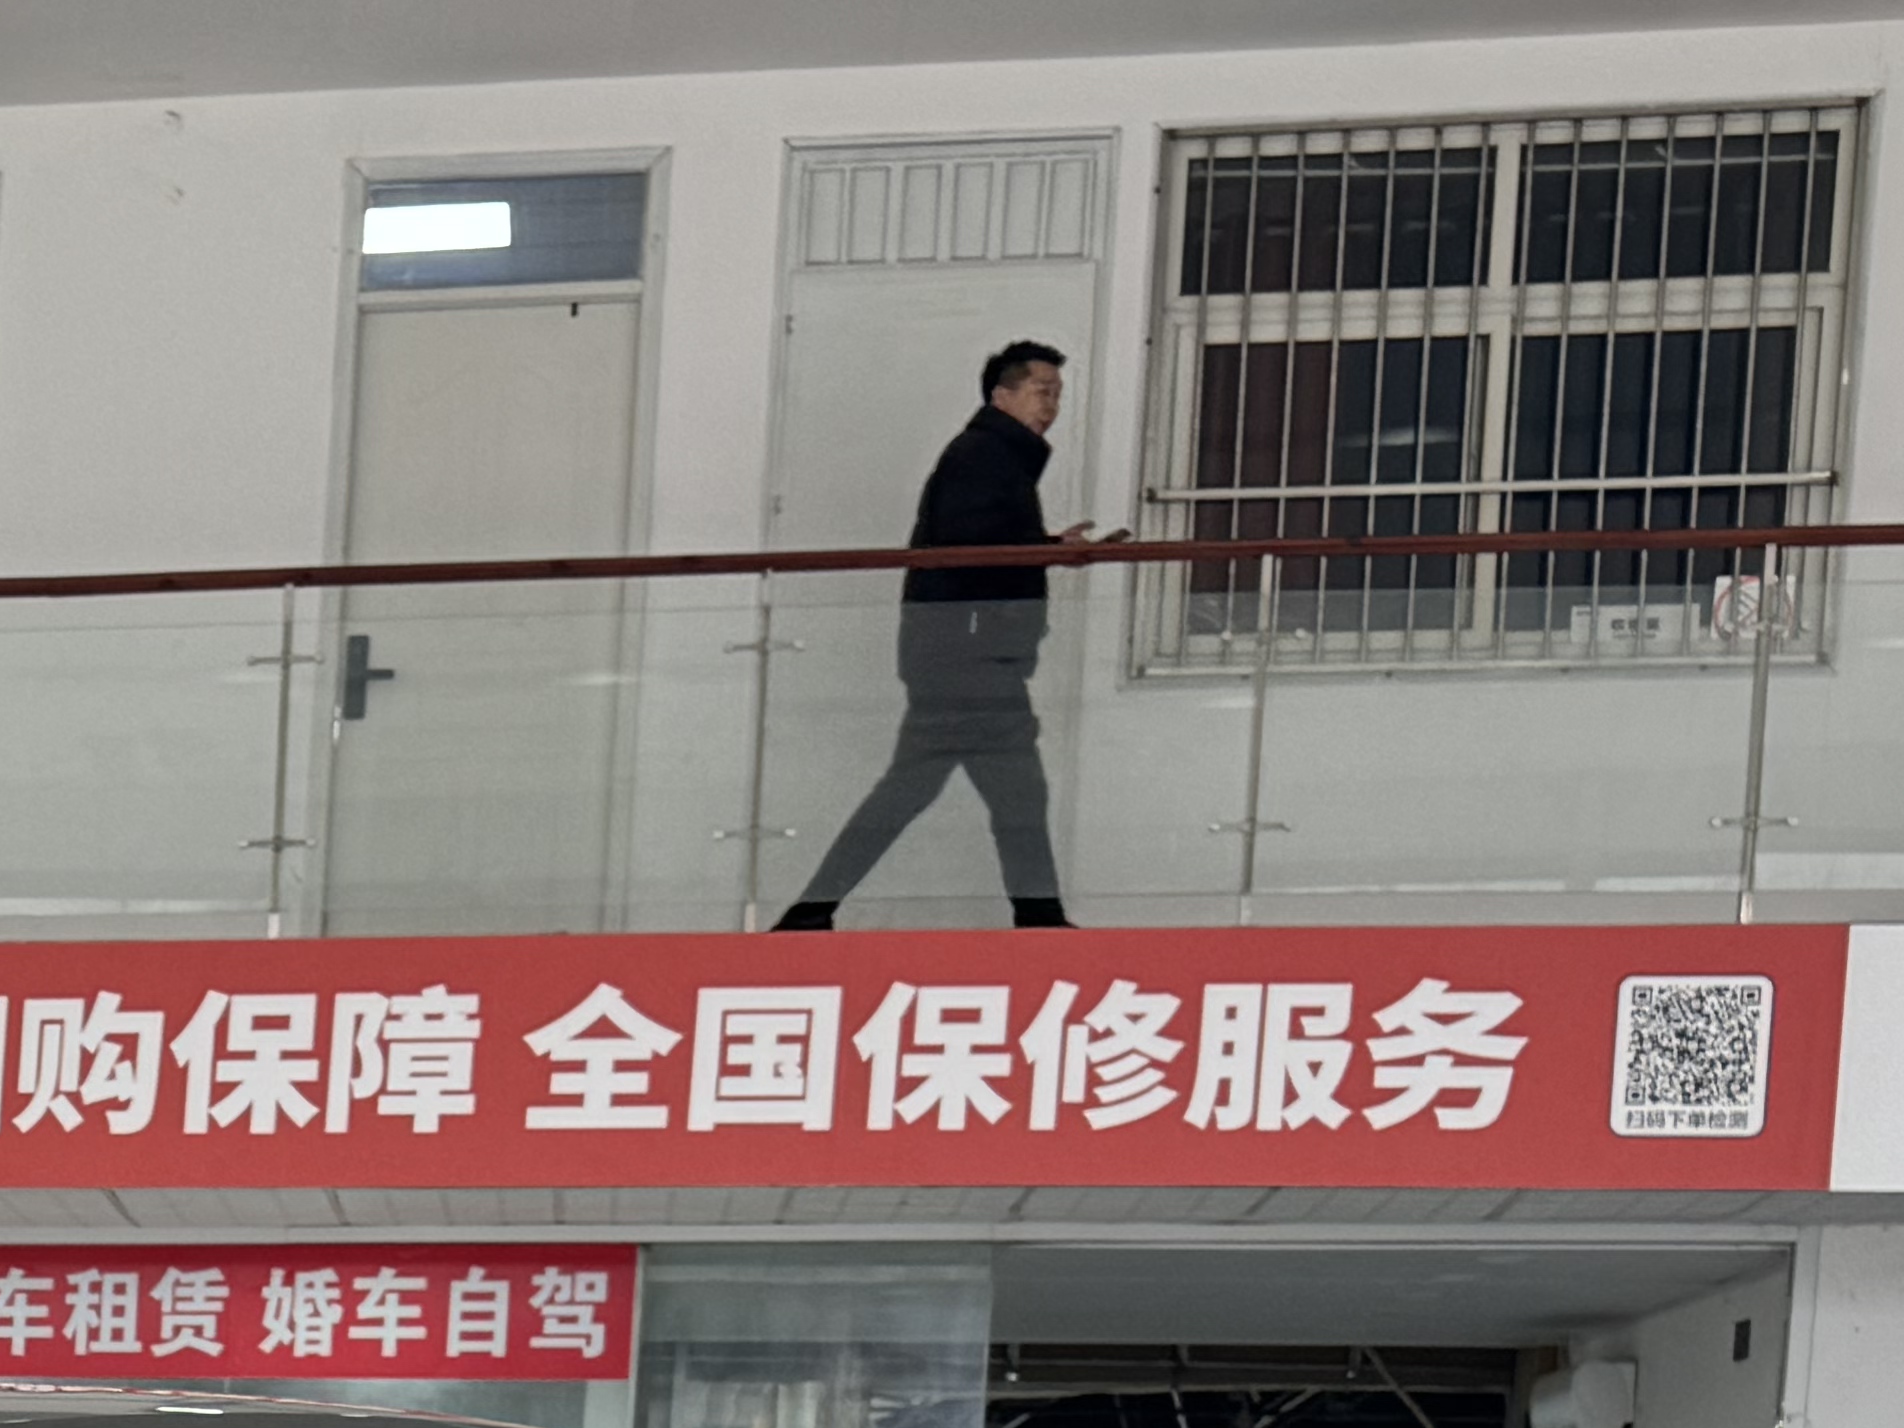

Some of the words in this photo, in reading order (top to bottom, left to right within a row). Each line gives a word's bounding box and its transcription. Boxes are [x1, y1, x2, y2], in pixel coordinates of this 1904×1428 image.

[522, 979, 1531, 1133] 全国保修服务
[1626, 1110, 1749, 1130] 扫码下单检测
[260, 1267, 610, 1358] 婚车自驾
